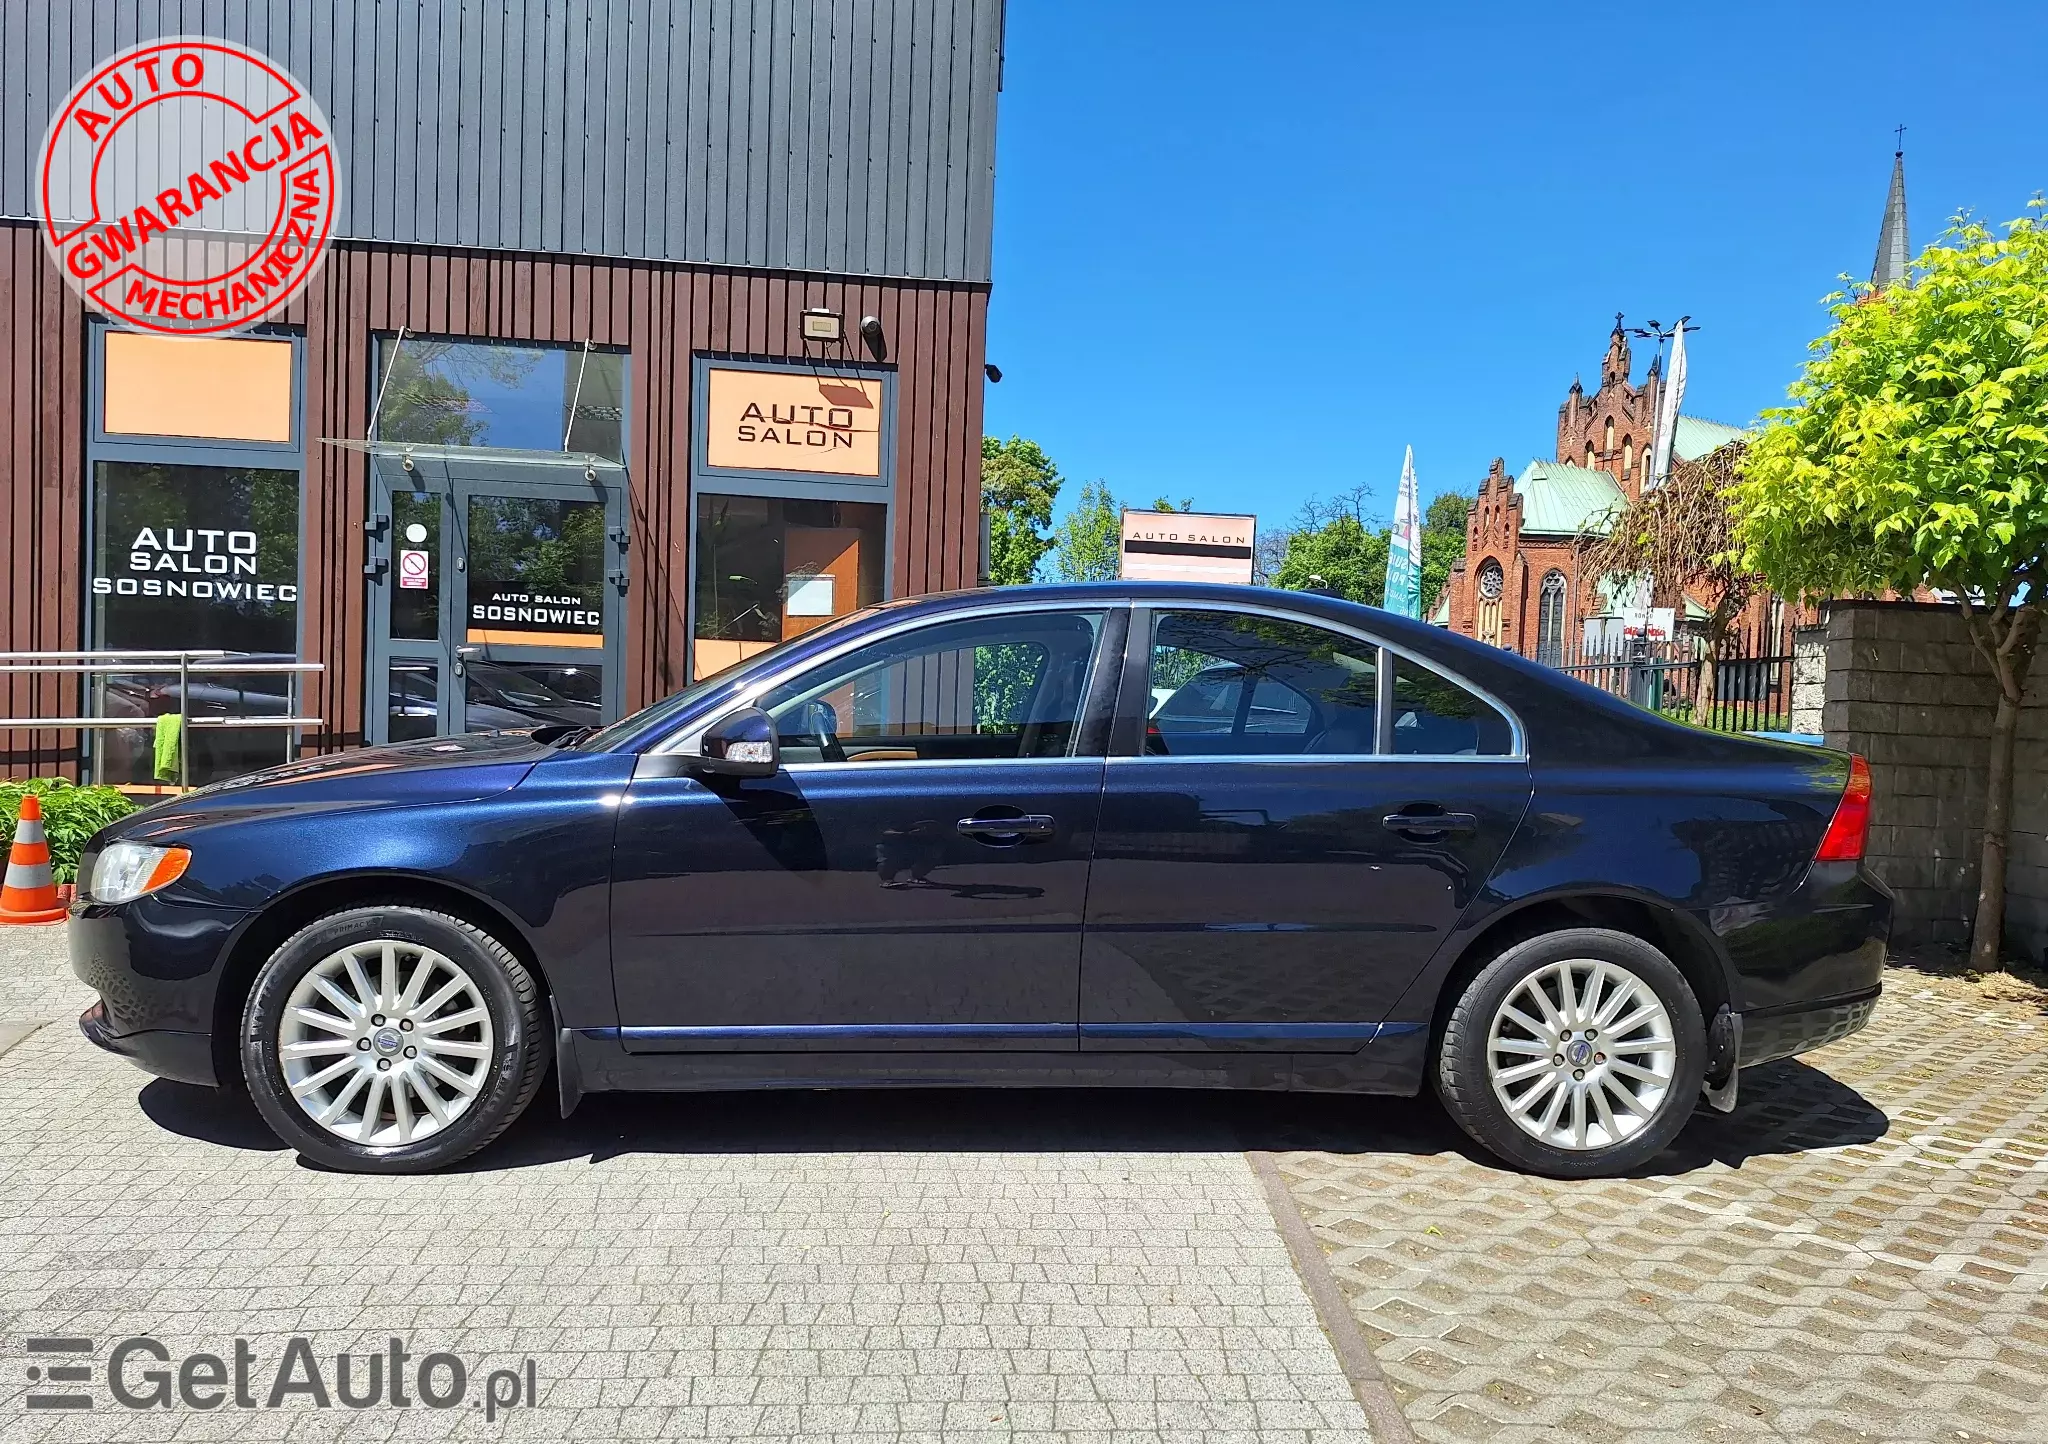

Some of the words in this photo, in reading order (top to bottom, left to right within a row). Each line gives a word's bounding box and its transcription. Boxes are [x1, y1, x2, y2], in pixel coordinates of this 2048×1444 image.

[740, 402, 853, 427] AUTO
[737, 425, 853, 448] SALON
[131, 527, 257, 555] AUTO
[1132, 531, 1178, 541] AUTO
[1187, 534, 1245, 544] SALON
[129, 551, 257, 575] SALON
[92, 577, 297, 602] SOSNOWIEC
[491, 592, 529, 603] AUTO
[534, 594, 581, 605] SALON
[472, 604, 600, 626] SOSNOWIEC
